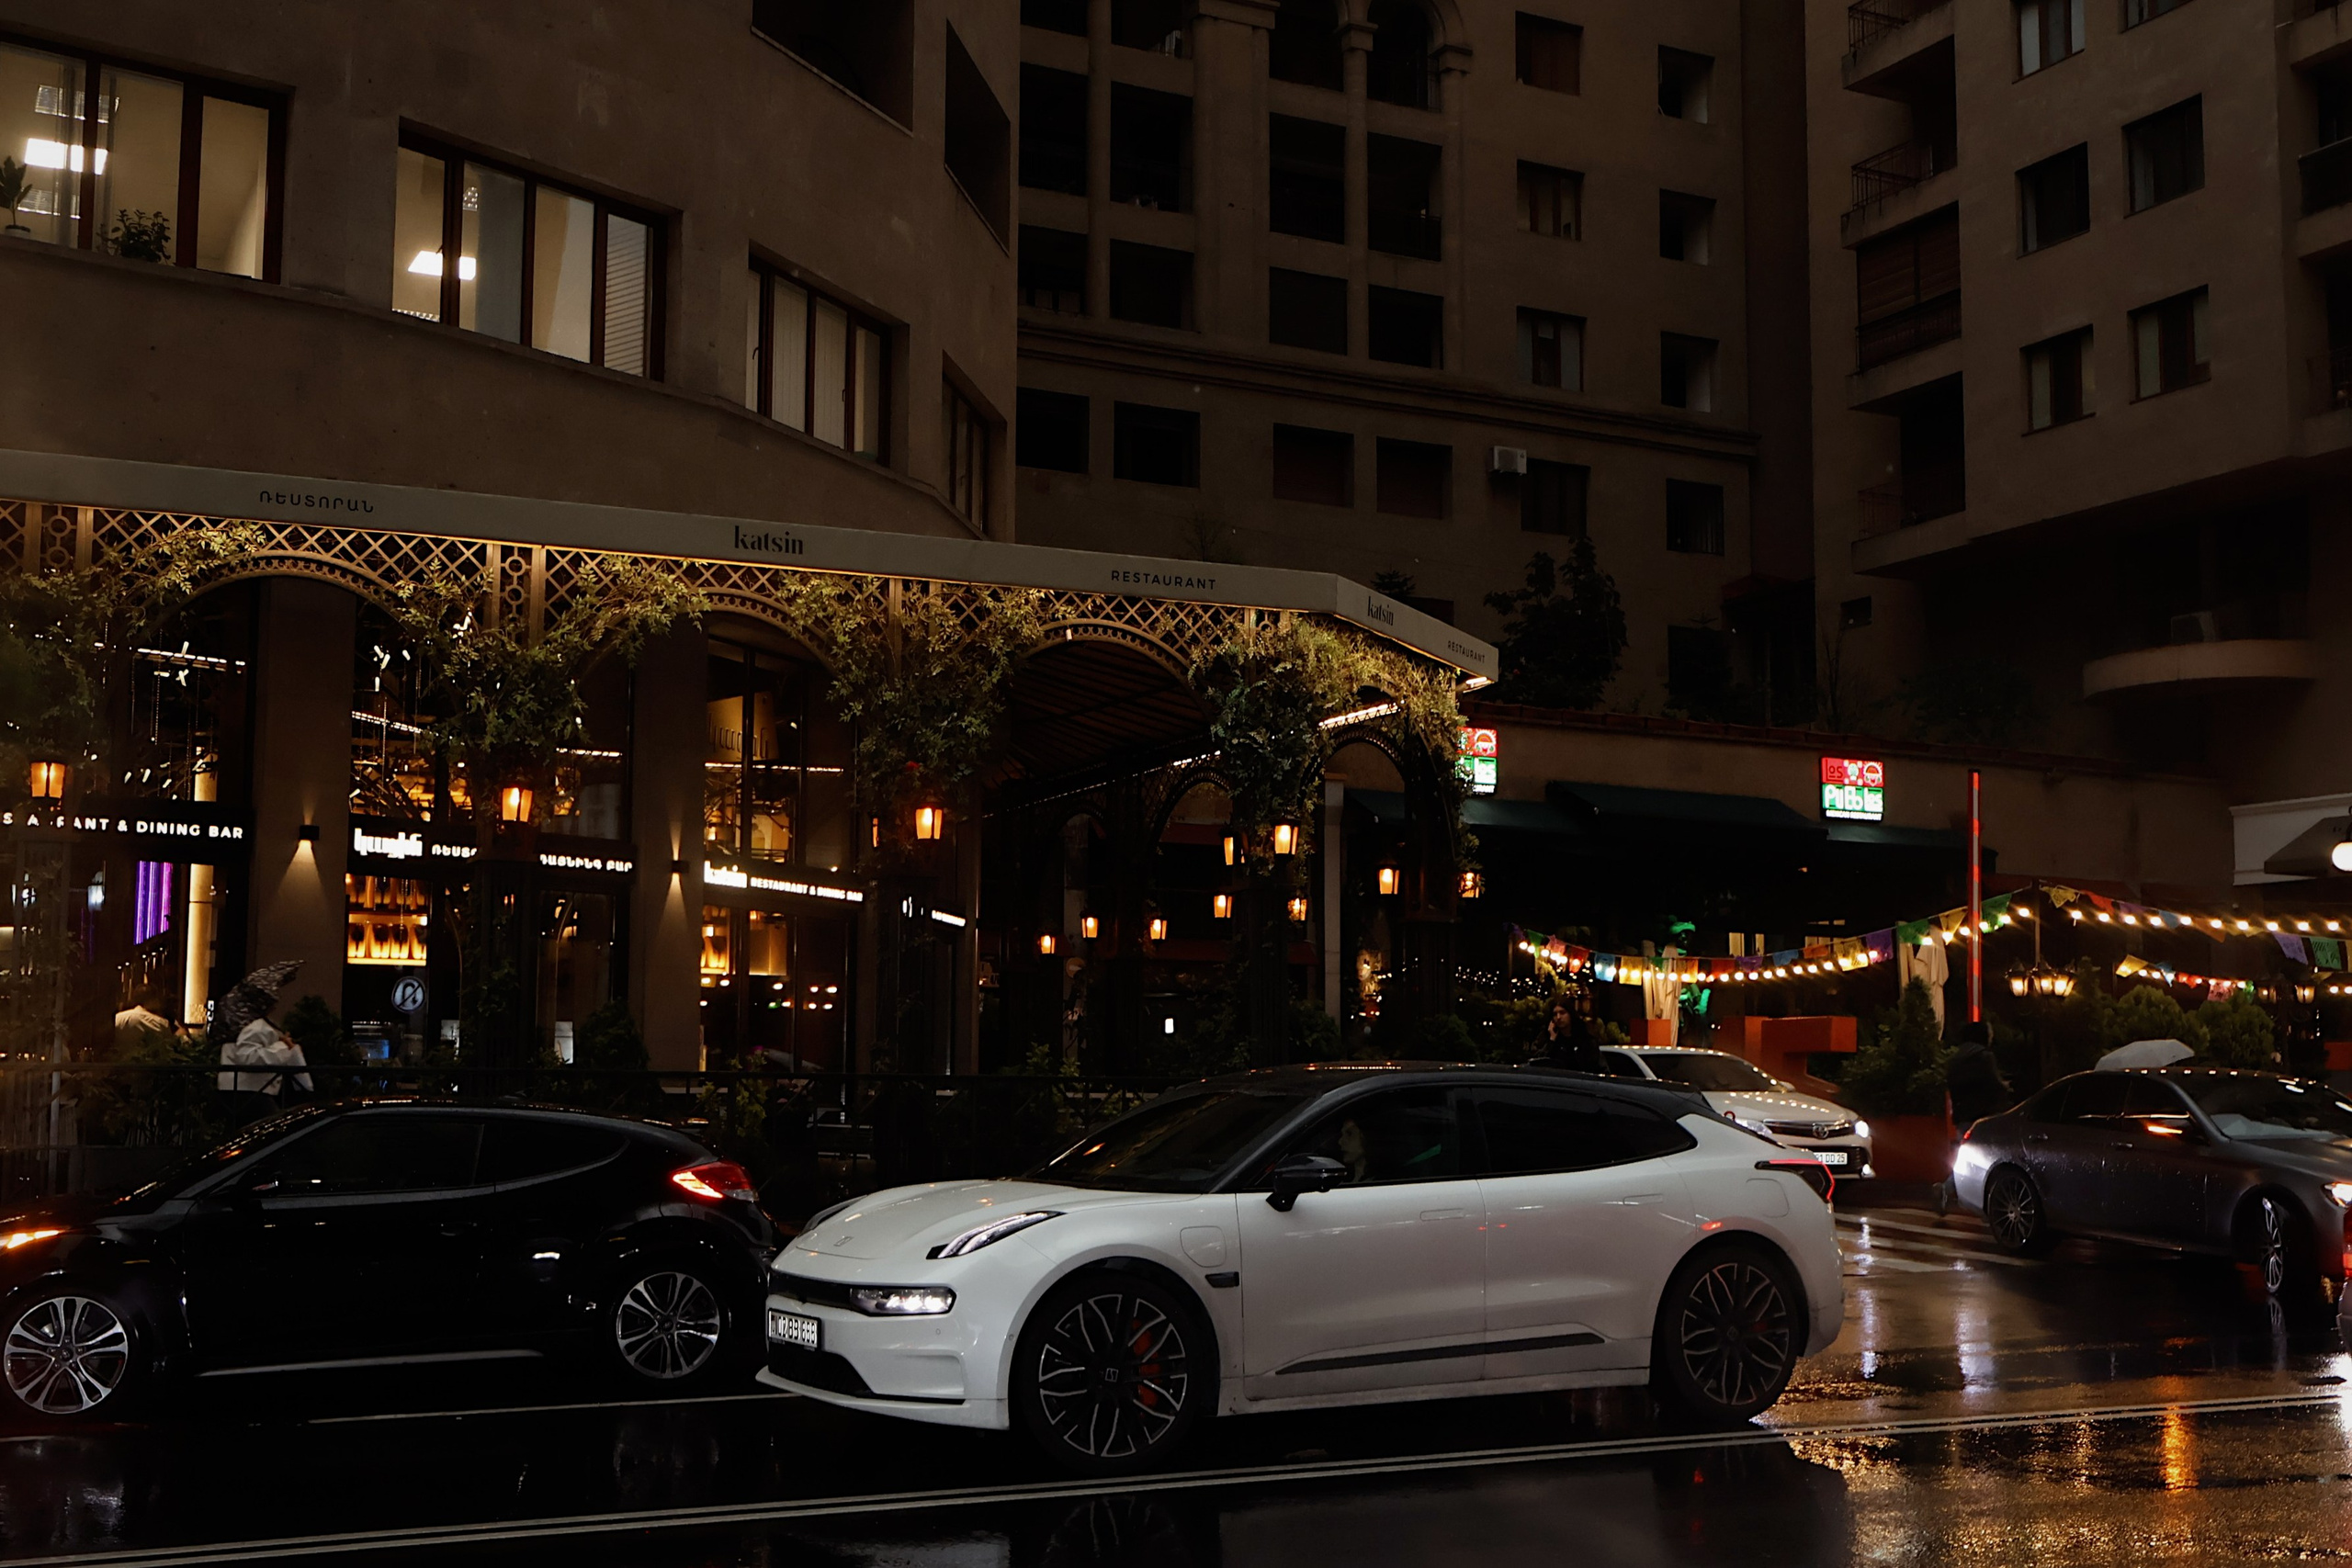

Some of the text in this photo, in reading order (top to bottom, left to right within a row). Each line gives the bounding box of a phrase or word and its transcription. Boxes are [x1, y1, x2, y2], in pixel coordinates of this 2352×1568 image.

[259, 491, 374, 513] ՌԵՍՏՈՐԱՆ
[734, 525, 803, 555] katsin
[1111, 570, 1216, 591] RESTAURANT
[1367, 595, 1395, 626] katsin
[1447, 640, 1486, 664] RESTAURANT
[117, 820, 128, 832] &
[136, 820, 200, 836] DINING
[208, 826, 243, 839] BAR
[750, 876, 808, 895] RESTAURANT
